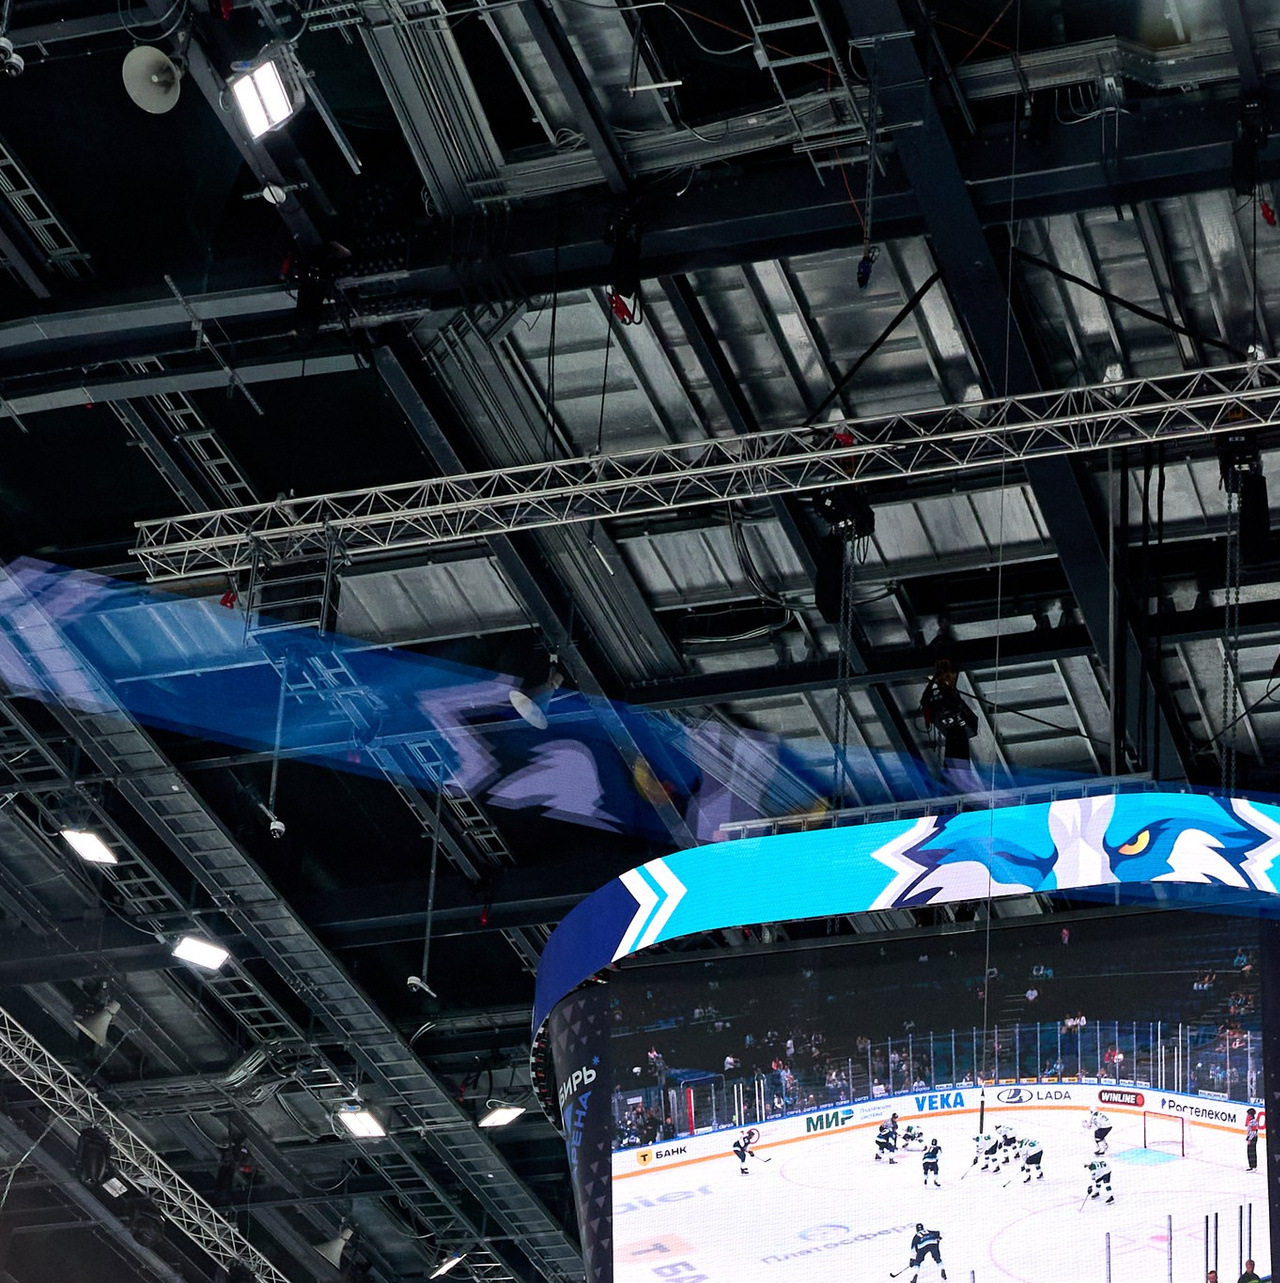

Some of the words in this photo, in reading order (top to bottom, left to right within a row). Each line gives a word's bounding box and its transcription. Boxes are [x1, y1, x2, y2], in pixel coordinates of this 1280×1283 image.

[559, 1066, 597, 1108] БИРЬ
[1037, 1090, 1071, 1101] LADA
[915, 1092, 965, 1112] VEKA
[1101, 1093, 1136, 1105] WINLINE
[806, 1109, 854, 1132] МИР
[1168, 1099, 1237, 1123] Ростелеком
[655, 1146, 687, 1159] БАНК
